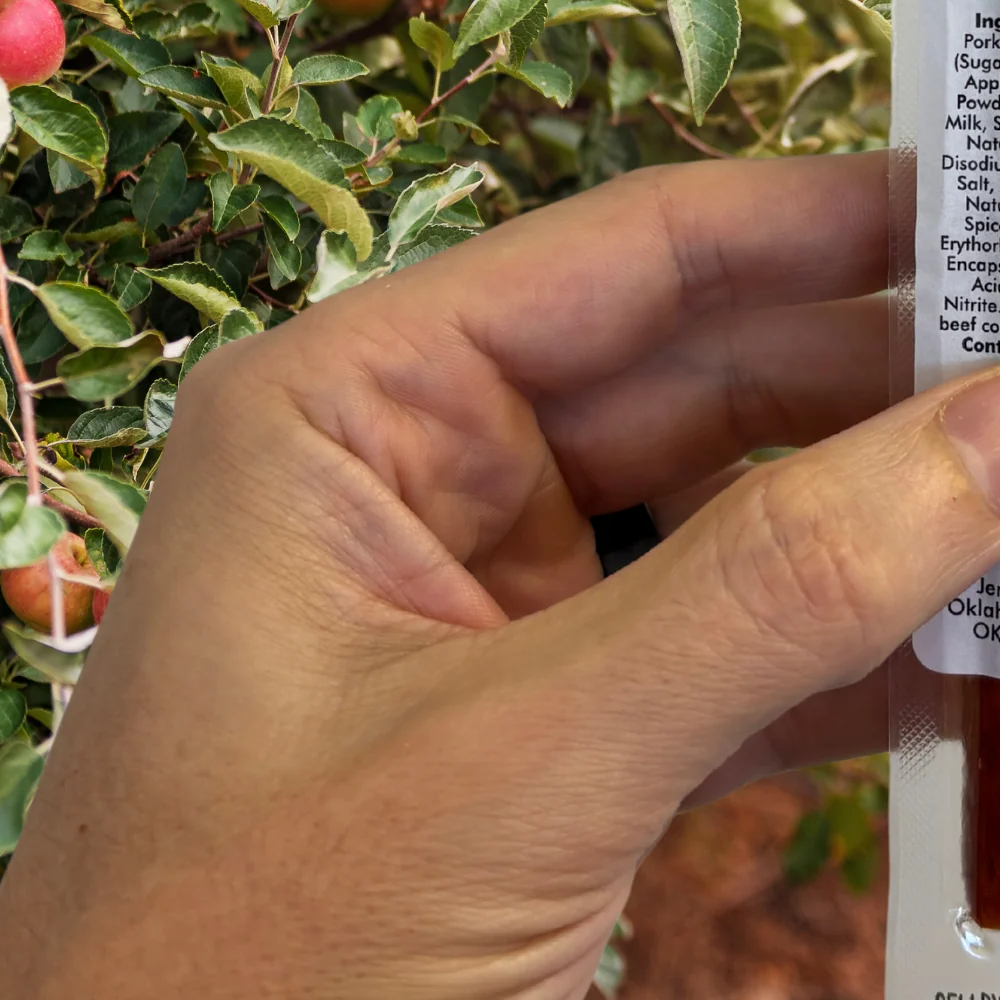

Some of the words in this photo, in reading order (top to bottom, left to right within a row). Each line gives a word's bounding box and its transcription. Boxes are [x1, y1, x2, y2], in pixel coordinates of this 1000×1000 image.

[945, 115, 987, 133] Milk,
[957, 176, 994, 194] Salt,
[940, 316, 977, 331] beef
